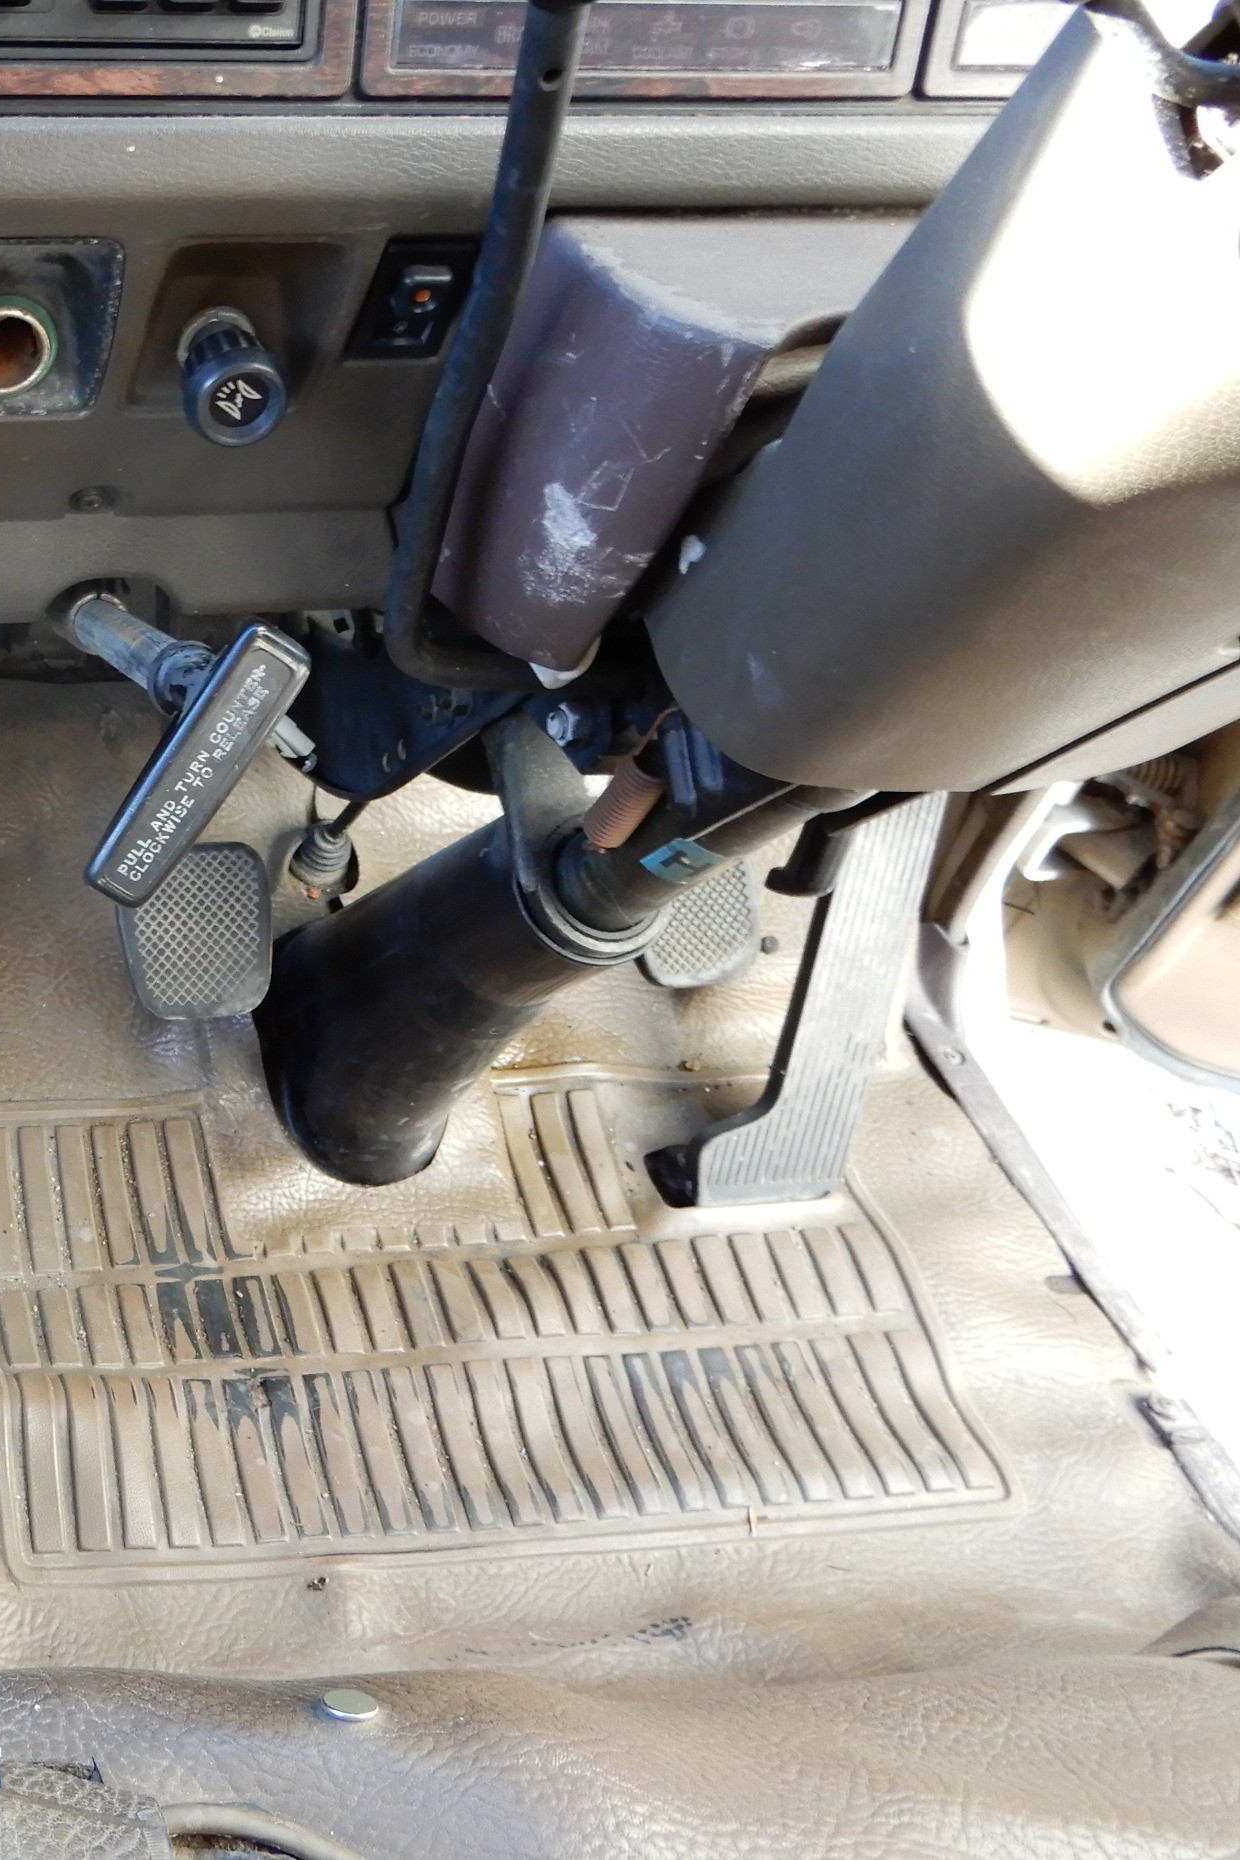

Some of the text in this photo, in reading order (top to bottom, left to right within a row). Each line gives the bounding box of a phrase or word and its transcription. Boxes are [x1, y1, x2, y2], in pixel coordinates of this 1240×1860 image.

[262, 26, 294, 38] Clarion
[117, 837, 153, 877] PULL
[151, 799, 177, 832] AND
[174, 750, 211, 793] TURN
[128, 686, 270, 882] CLOCKWISE TO RELEASE
